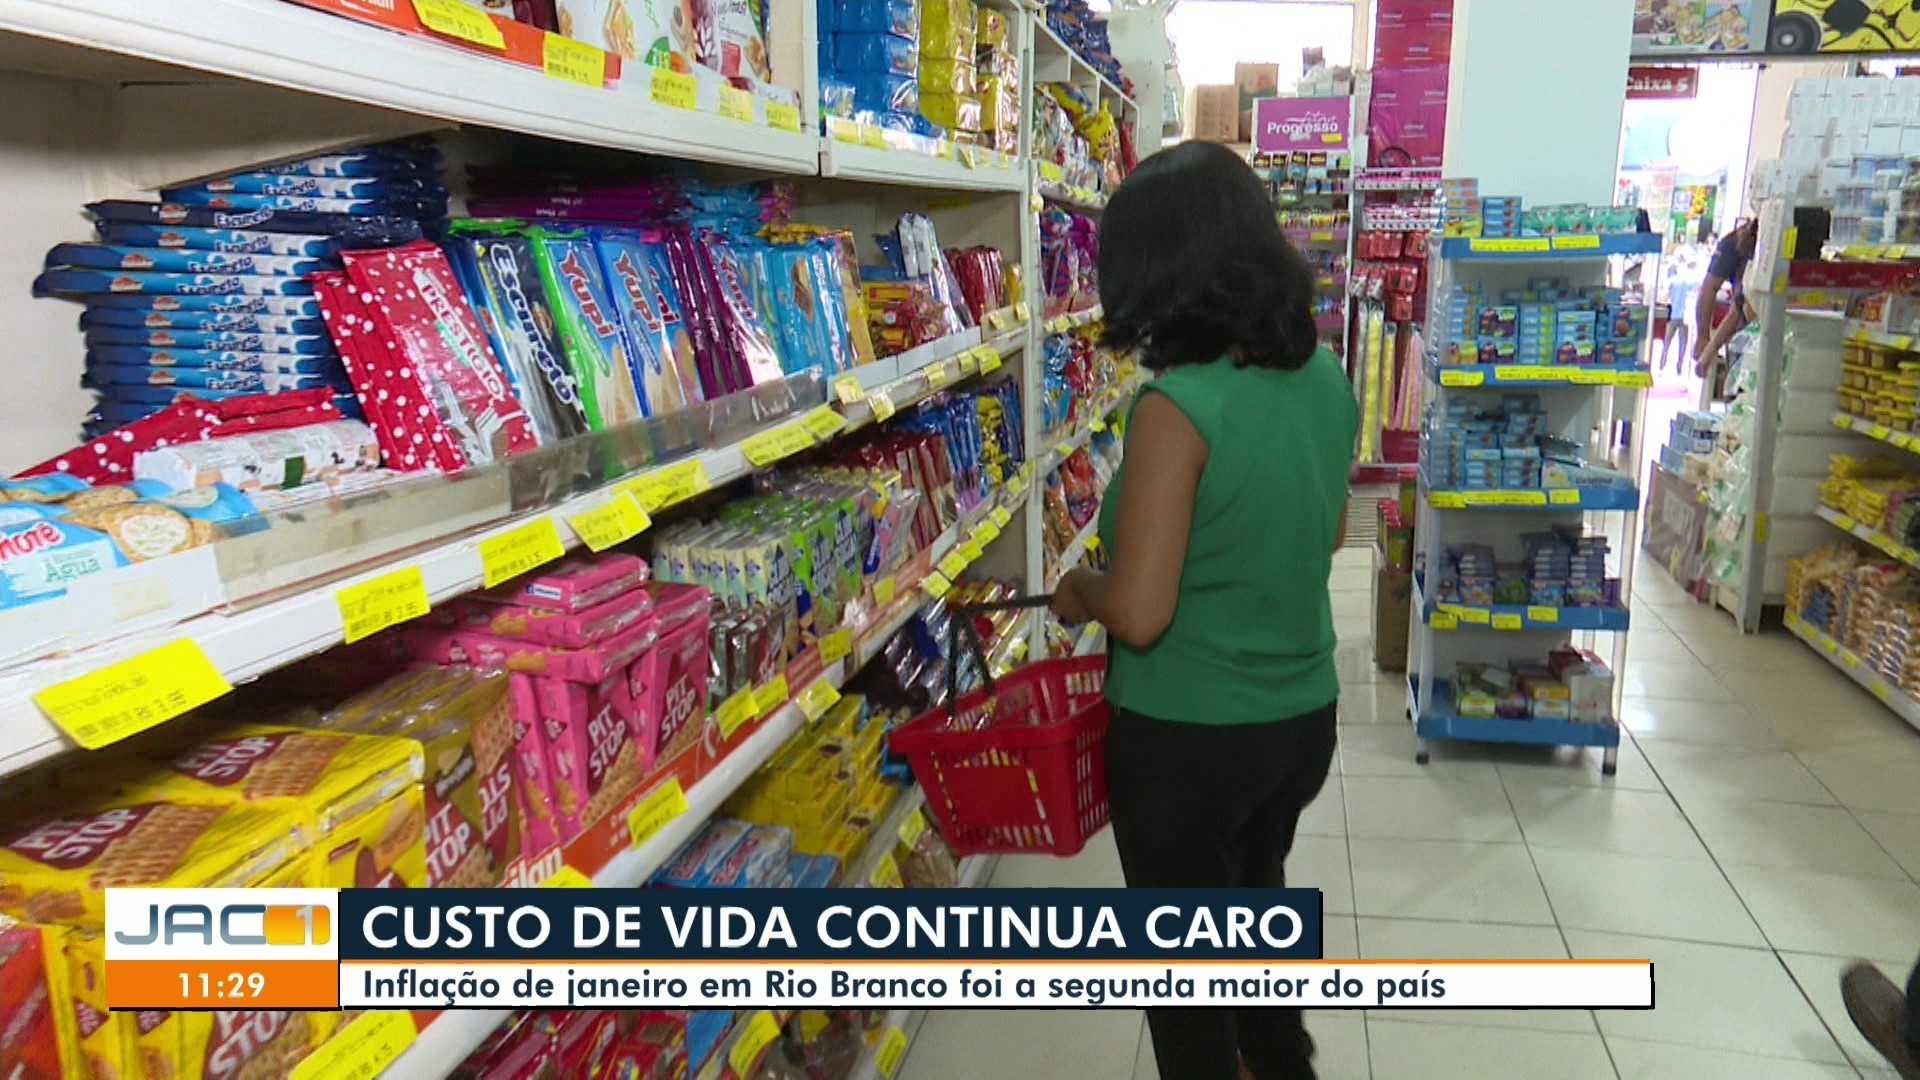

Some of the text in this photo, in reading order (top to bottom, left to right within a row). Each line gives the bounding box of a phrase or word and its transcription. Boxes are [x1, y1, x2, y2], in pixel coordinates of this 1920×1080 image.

[1676, 77, 1689, 92] 5
[1267, 121, 1339, 137] Progresso
[560, 252, 617, 337] Yupi
[614, 250, 662, 332] Yupi
[421, 284, 502, 398] PRESTIGIO
[491, 244, 575, 404] Escureto
[661, 688, 697, 741] STOP
[667, 673, 689, 711] PIT
[588, 703, 614, 749] PIT
[590, 719, 627, 778] STOP
[196, 736, 275, 777] STOP
[42, 808, 138, 859] STOP
[426, 821, 470, 888] TOP
